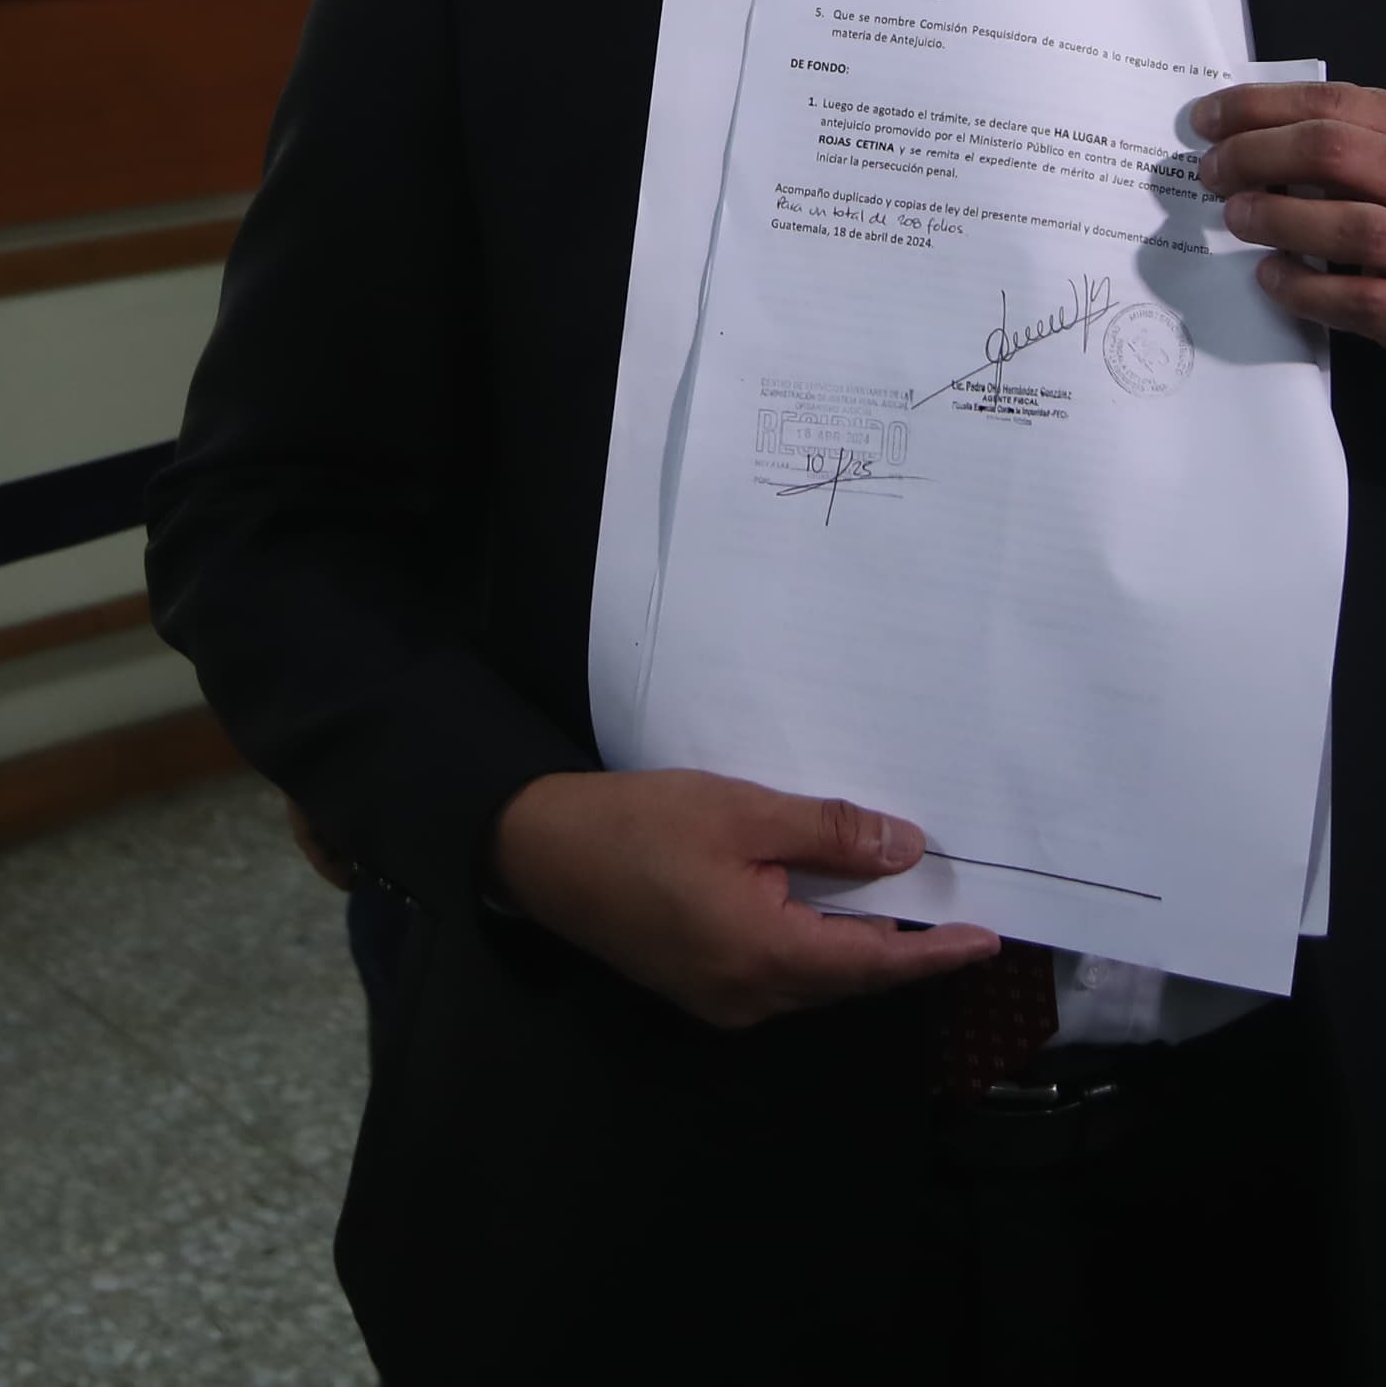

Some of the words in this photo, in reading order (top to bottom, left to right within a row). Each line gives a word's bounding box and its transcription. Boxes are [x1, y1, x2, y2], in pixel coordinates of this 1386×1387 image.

[815, 7, 825, 18] 5.
[833, 9, 855, 21] Que
[859, 14, 870, 22] se
[874, 14, 916, 28] nombre
[919, 19, 967, 34] Comisión
[972, 25, 1037, 44] Pesquisidora
[1041, 35, 1054, 47] de
[1059, 40, 1099, 56] acuerdo
[1102, 50, 1109, 59] a
[1112, 51, 1122, 61] lo
[1125, 54, 1168, 71] regulado
[1172, 63, 1185, 74] en
[1189, 64, 1199, 75] la
[1203, 66, 1218, 79] ley
[832, 28, 871, 41] materia
[874, 31, 887, 42] de
[890, 34, 946, 49] Antejuicio.
[790, 58, 804, 69] DE
[807, 61, 850, 74] FONDO:
[808, 97, 818, 107] 1.
[823, 98, 854, 112] Luego
[856, 102, 870, 113] de
[872, 105, 914, 118] agotado
[918, 110, 928, 120] el
[930, 111, 971, 126] trámite,
[974, 118, 986, 127] se
[989, 118, 1027, 133] declare
[1031, 124, 1051, 136] que
[1054, 127, 1070, 139] HA
[1072, 131, 1108, 146] LUGAR
[1110, 139, 1116, 148] a
[1119, 139, 1169, 158] formación
[1172, 150, 1184, 161] de
[820, 117, 871, 131] antejuicio
[874, 124, 931, 139] promovido
[934, 131, 952, 142] por
[956, 132, 966, 142] el
[969, 134, 1023, 150] Ministerio
[1026, 140, 1064, 156] Público
[1068, 150, 1081, 160] en
[1085, 153, 1117, 166] contra
[1120, 158, 1133, 170] de
[1136, 161, 1184, 179] RANULFO
[818, 134, 851, 147] ROJAS
[856, 139, 894, 152] CETINA
[899, 146, 906, 155] y
[910, 147, 922, 156] se
[926, 149, 959, 161] remita
[965, 152, 974, 162] el
[979, 156, 1037, 171] expediente
[1042, 163, 1055, 174] de
[1060, 164, 1095, 180] mérito
[1099, 172, 1109, 183] al
[1138, 181, 1197, 200] competente
[850, 155, 859, 166] la
[862, 159, 924, 175] persecución
[926, 167, 958, 180] penal.
[775, 183, 830, 200] Acompaño
[833, 189, 883, 206] duplicado
[885, 198, 891, 208] y
[894, 199, 927, 212] copias
[929, 202, 942, 213] de
[945, 204, 960, 216] ley
[963, 207, 979, 218] del
[981, 210, 1027, 224] presente
[1030, 217, 1081, 232] memorial
[1084, 225, 1090, 235] y
[1092, 225, 1169, 248] documentación
[1171, 241, 1213, 256] adjunta.
[777, 196, 802, 211] Para
[809, 206, 827, 217] un
[833, 204, 864, 222] total
[869, 211, 886, 226] de
[897, 214, 922, 229] 208
[771, 218, 830, 236] Guatemala,
[834, 226, 846, 237] 18
[849, 228, 862, 239] de
[865, 230, 888, 243] abril
[890, 233, 904, 245] de
[906, 235, 934, 248] 2024.
[982, 394, 1011, 404] AGENTE
[1012, 397, 1039, 407] FISCAL
